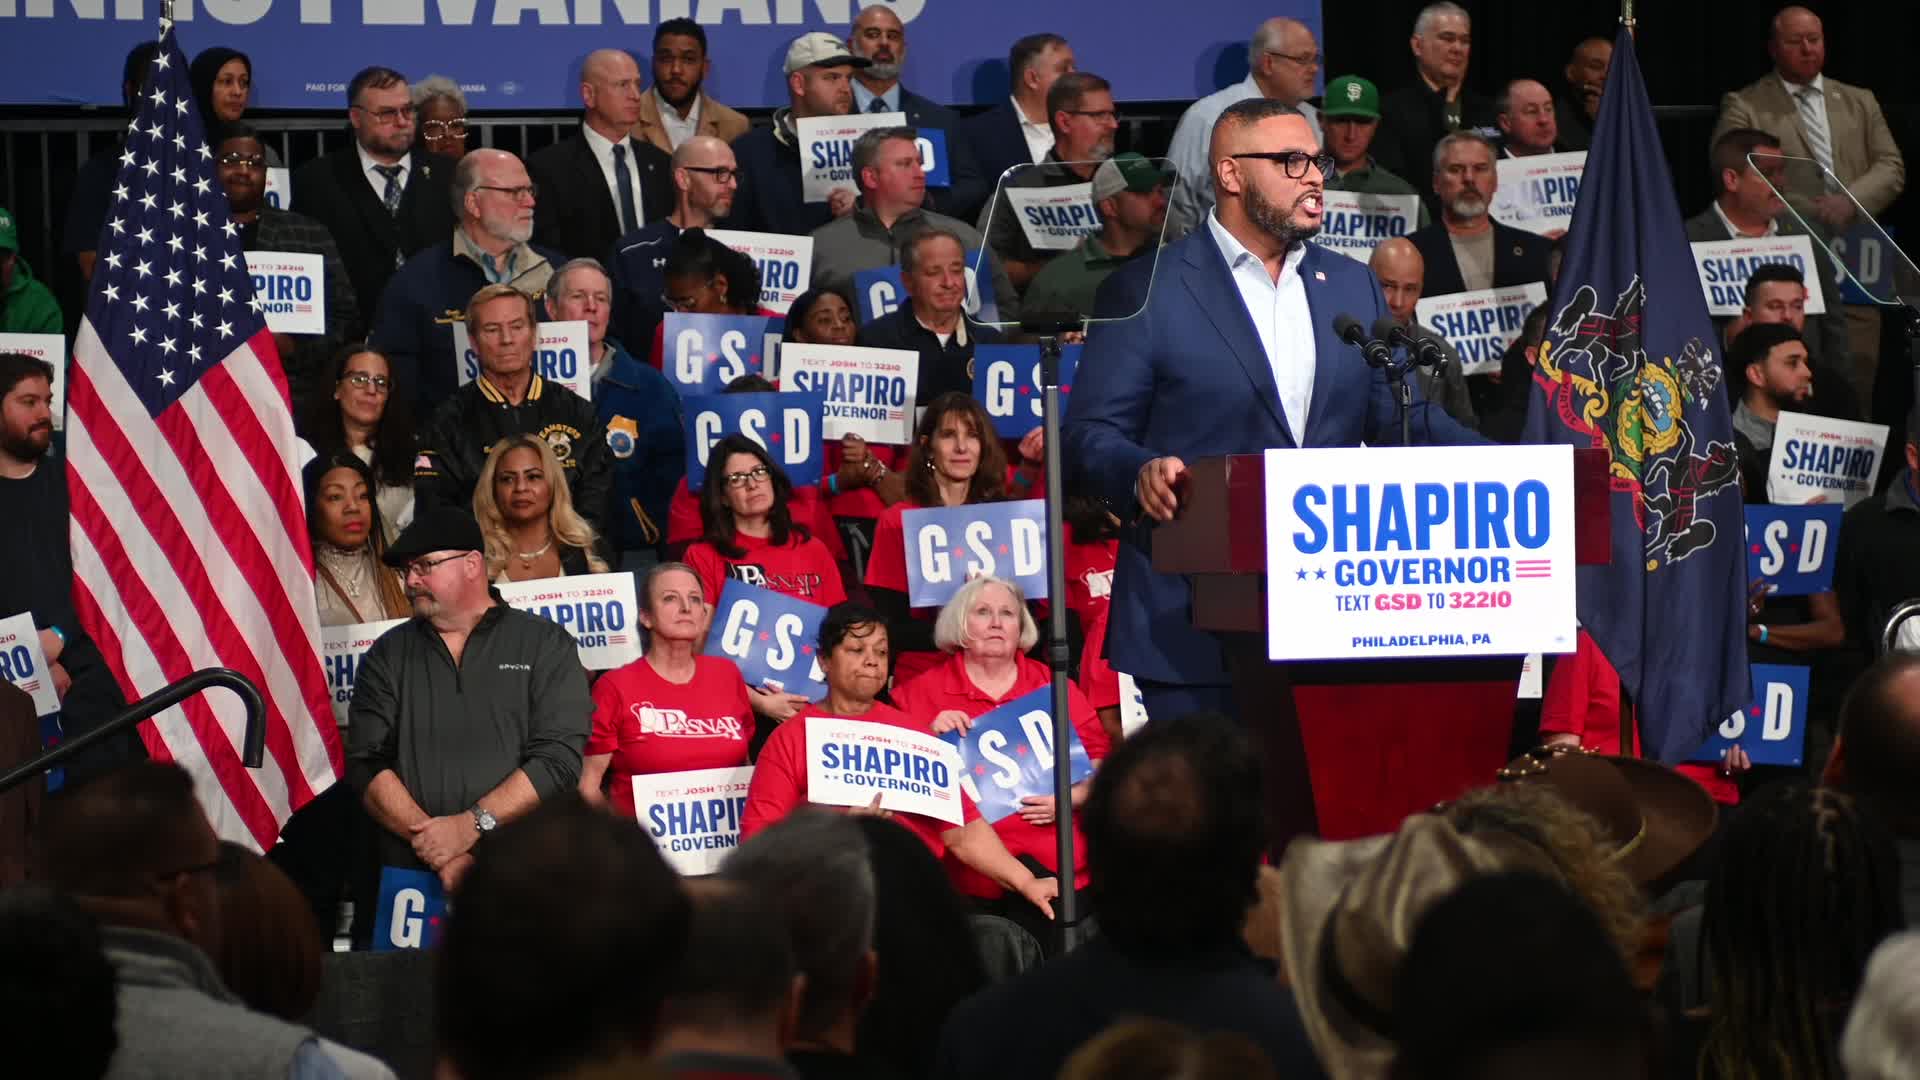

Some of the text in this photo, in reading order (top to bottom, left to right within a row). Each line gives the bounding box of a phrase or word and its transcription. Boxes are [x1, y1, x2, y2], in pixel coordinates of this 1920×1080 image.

[1024, 203, 1097, 226] SHAPI
[1455, 335, 1505, 365] AVIS
[830, 360, 857, 368] JOSH
[793, 370, 906, 407] SHAPIRO
[823, 404, 887, 421] OVERNOR
[1782, 438, 1876, 480] SHAPIRO
[1292, 479, 1550, 554] SHAPIRO
[1335, 556, 1511, 587] GOVERNOR
[531, 591, 563, 601] JOSH
[1336, 590, 1512, 611] TEXT GSD TO 32210
[1352, 633, 1491, 648] PHILADELPHIA, PA
[860, 733, 892, 744] JOSH
[821, 742, 949, 788] SHAPIRO
[683, 786, 714, 796] JOSH
[843, 772, 932, 797] GOVERNOR
[671, 834, 741, 852] GOVERN
